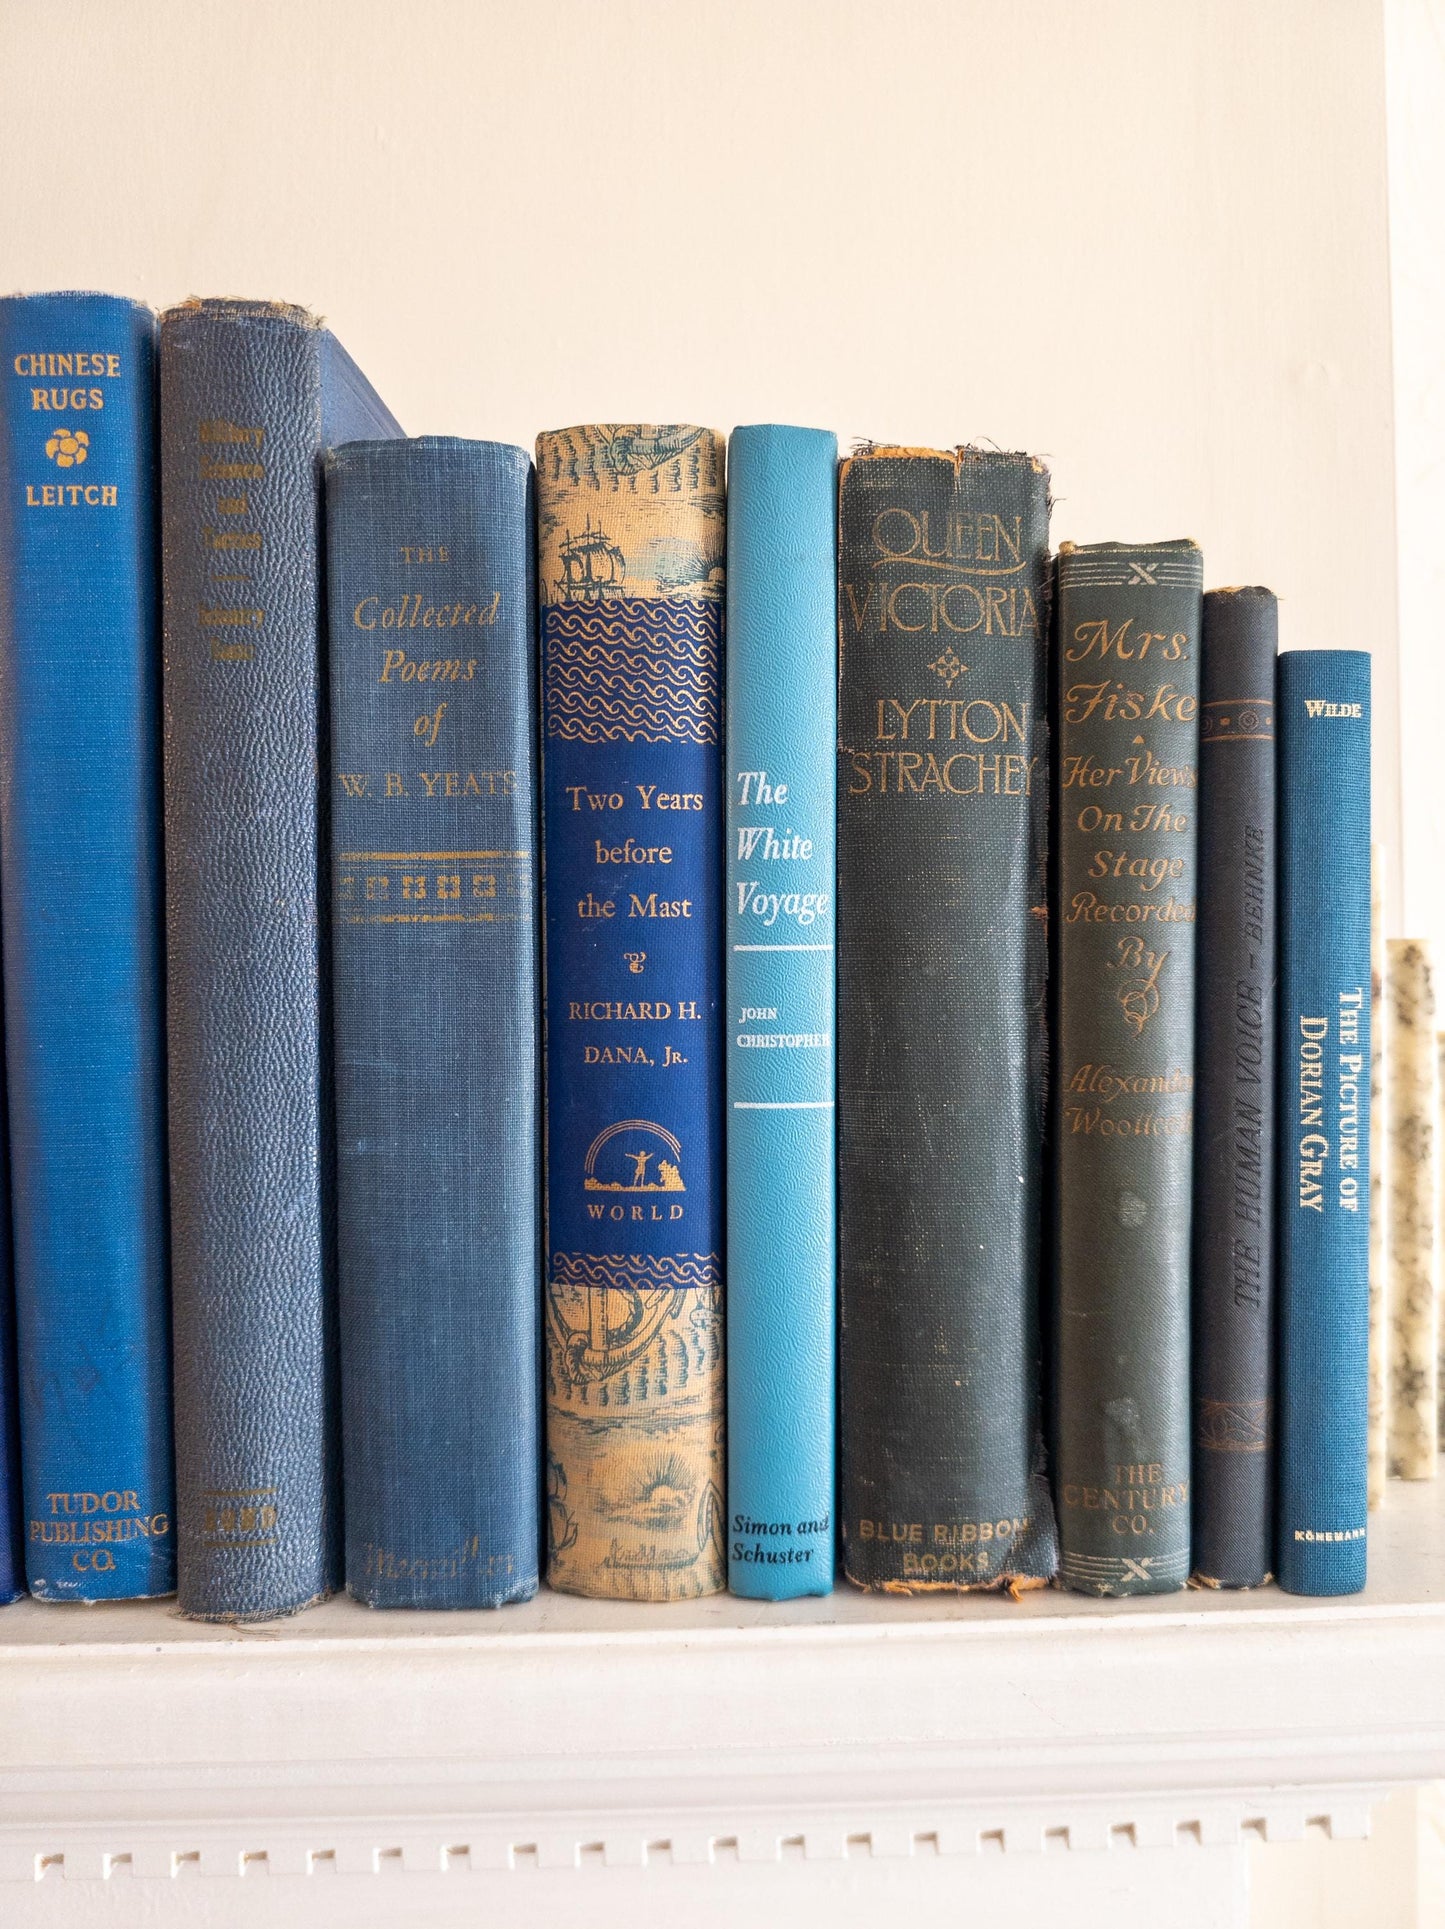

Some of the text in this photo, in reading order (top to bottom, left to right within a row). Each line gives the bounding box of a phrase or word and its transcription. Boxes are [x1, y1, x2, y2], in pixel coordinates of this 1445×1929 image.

[14, 353, 122, 378] CHINESE
[31, 387, 105, 411] RUGS
[26, 485, 118, 507] LEITCH
[870, 508, 1024, 566] QUEEN
[400, 546, 450, 565] THE
[352, 591, 501, 630] Collected
[846, 582, 1038, 636] VICTORIA
[1066, 618, 1190, 662] Mrs.
[378, 650, 479, 683] Poems
[1065, 679, 1198, 724] Fiske
[1304, 700, 1362, 718] WILDE
[413, 702, 449, 747] of
[876, 699, 1028, 743] LYTTON
[848, 753, 1038, 796] STRACHEY
[1061, 751, 1198, 788] Her Views
[338, 770, 519, 798] W. B. YEATS
[565, 785, 704, 811] Two Years
[737, 771, 789, 806] The
[1077, 804, 1188, 832] On The
[594, 838, 673, 864] before
[737, 827, 813, 861] White
[1088, 850, 1185, 892] Stage
[1244, 825, 1263, 946] BEHNKE
[577, 893, 693, 918] the Mast
[736, 881, 830, 926] Voyage
[1106, 935, 1170, 1006] By
[569, 1001, 702, 1020] RICHARD H.
[739, 1007, 777, 1024] JOHN
[736, 1033, 831, 1048] CHRISTOPHER
[1236, 980, 1263, 1085] VOICE
[584, 1046, 655, 1067] DANA,
[1339, 987, 1363, 1212] THE PICTURE OF
[1299, 1015, 1329, 1213] DORIAN GRAY
[1234, 1101, 1262, 1230] HUMAN
[586, 1204, 683, 1221] WORLD
[1232, 1238, 1261, 1309] THE
[1114, 1463, 1162, 1485] THE
[46, 1489, 141, 1514] TUDOR
[1062, 1483, 1189, 1511] CENTURY
[29, 1513, 169, 1542] PUBLISHING
[733, 1511, 830, 1535] Simon and
[859, 1517, 1028, 1543] BLUE RIBBON
[1112, 1514, 1156, 1535] CO.
[733, 1542, 814, 1563] Schuster
[903, 1551, 989, 1574] BOOKS
